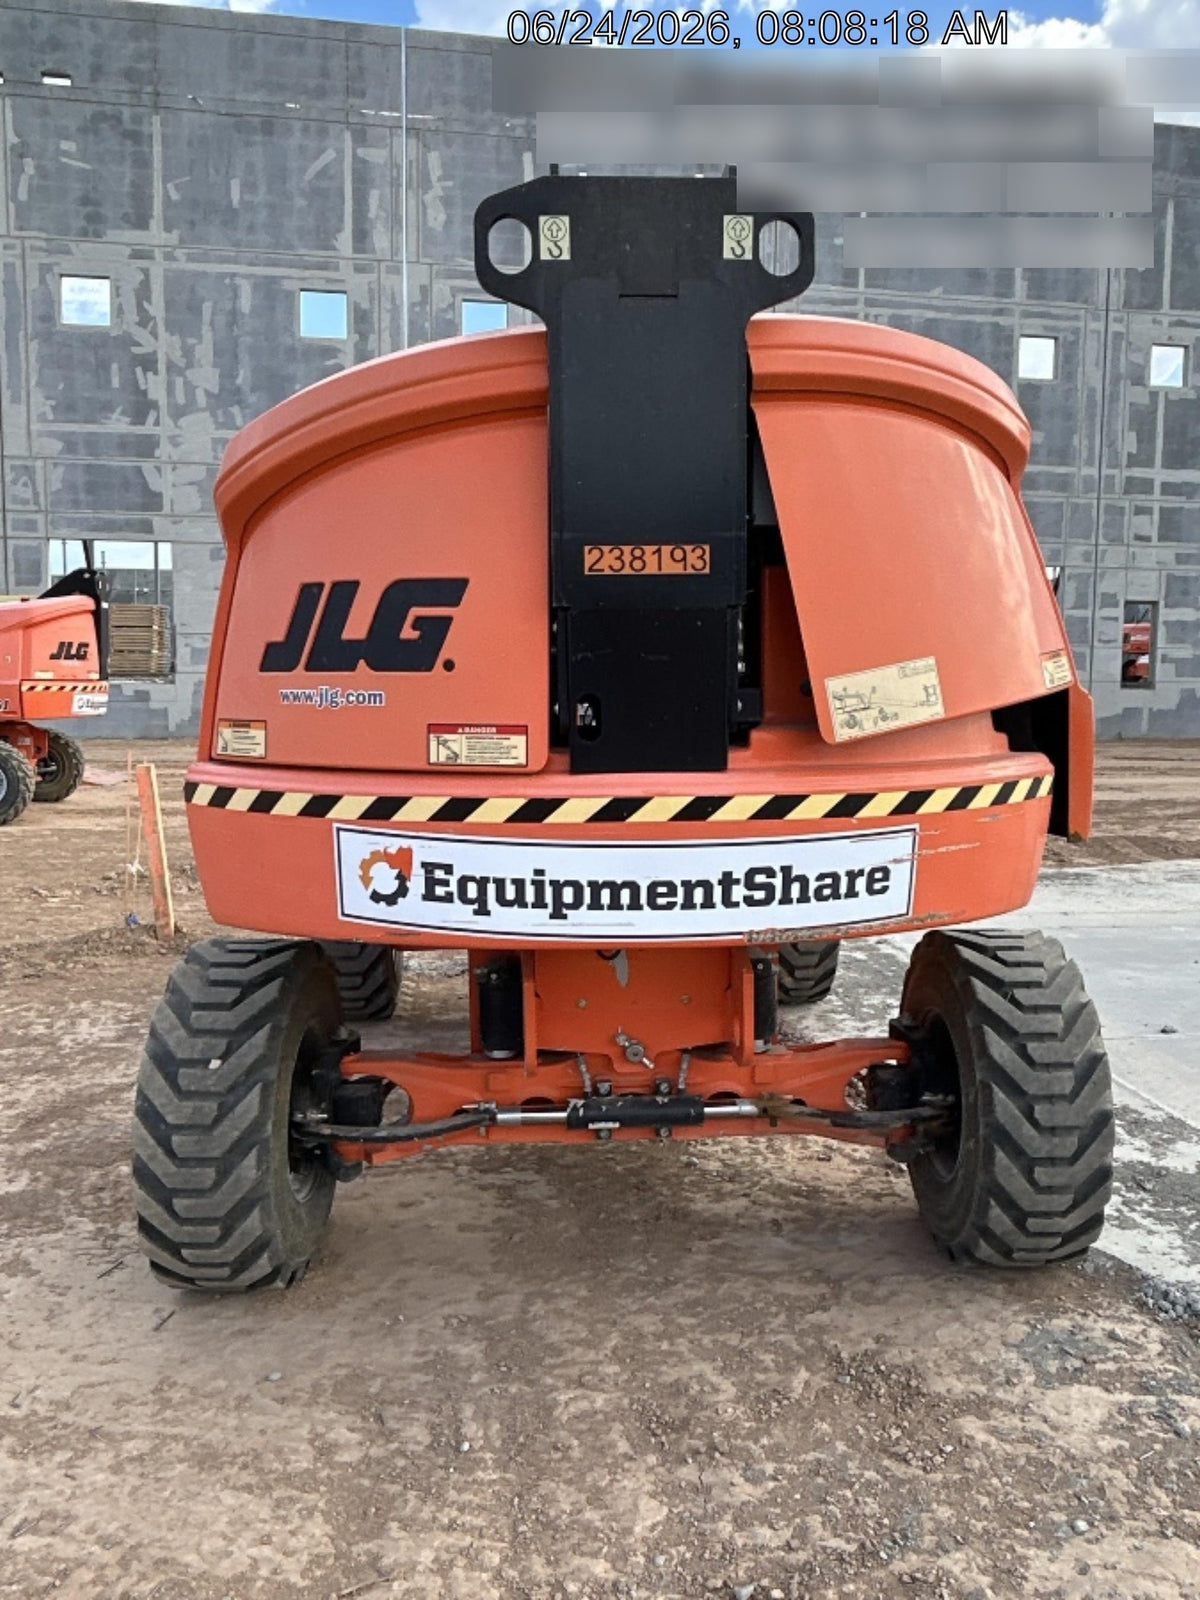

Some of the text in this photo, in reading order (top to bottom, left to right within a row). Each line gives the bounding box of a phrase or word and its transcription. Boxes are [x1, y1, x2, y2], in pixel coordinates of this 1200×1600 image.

[587, 546, 708, 573] 238193
[49, 641, 89, 661] JLG
[279, 686, 386, 709] www.jlg.com
[420, 860, 892, 921] EquipmentShare
